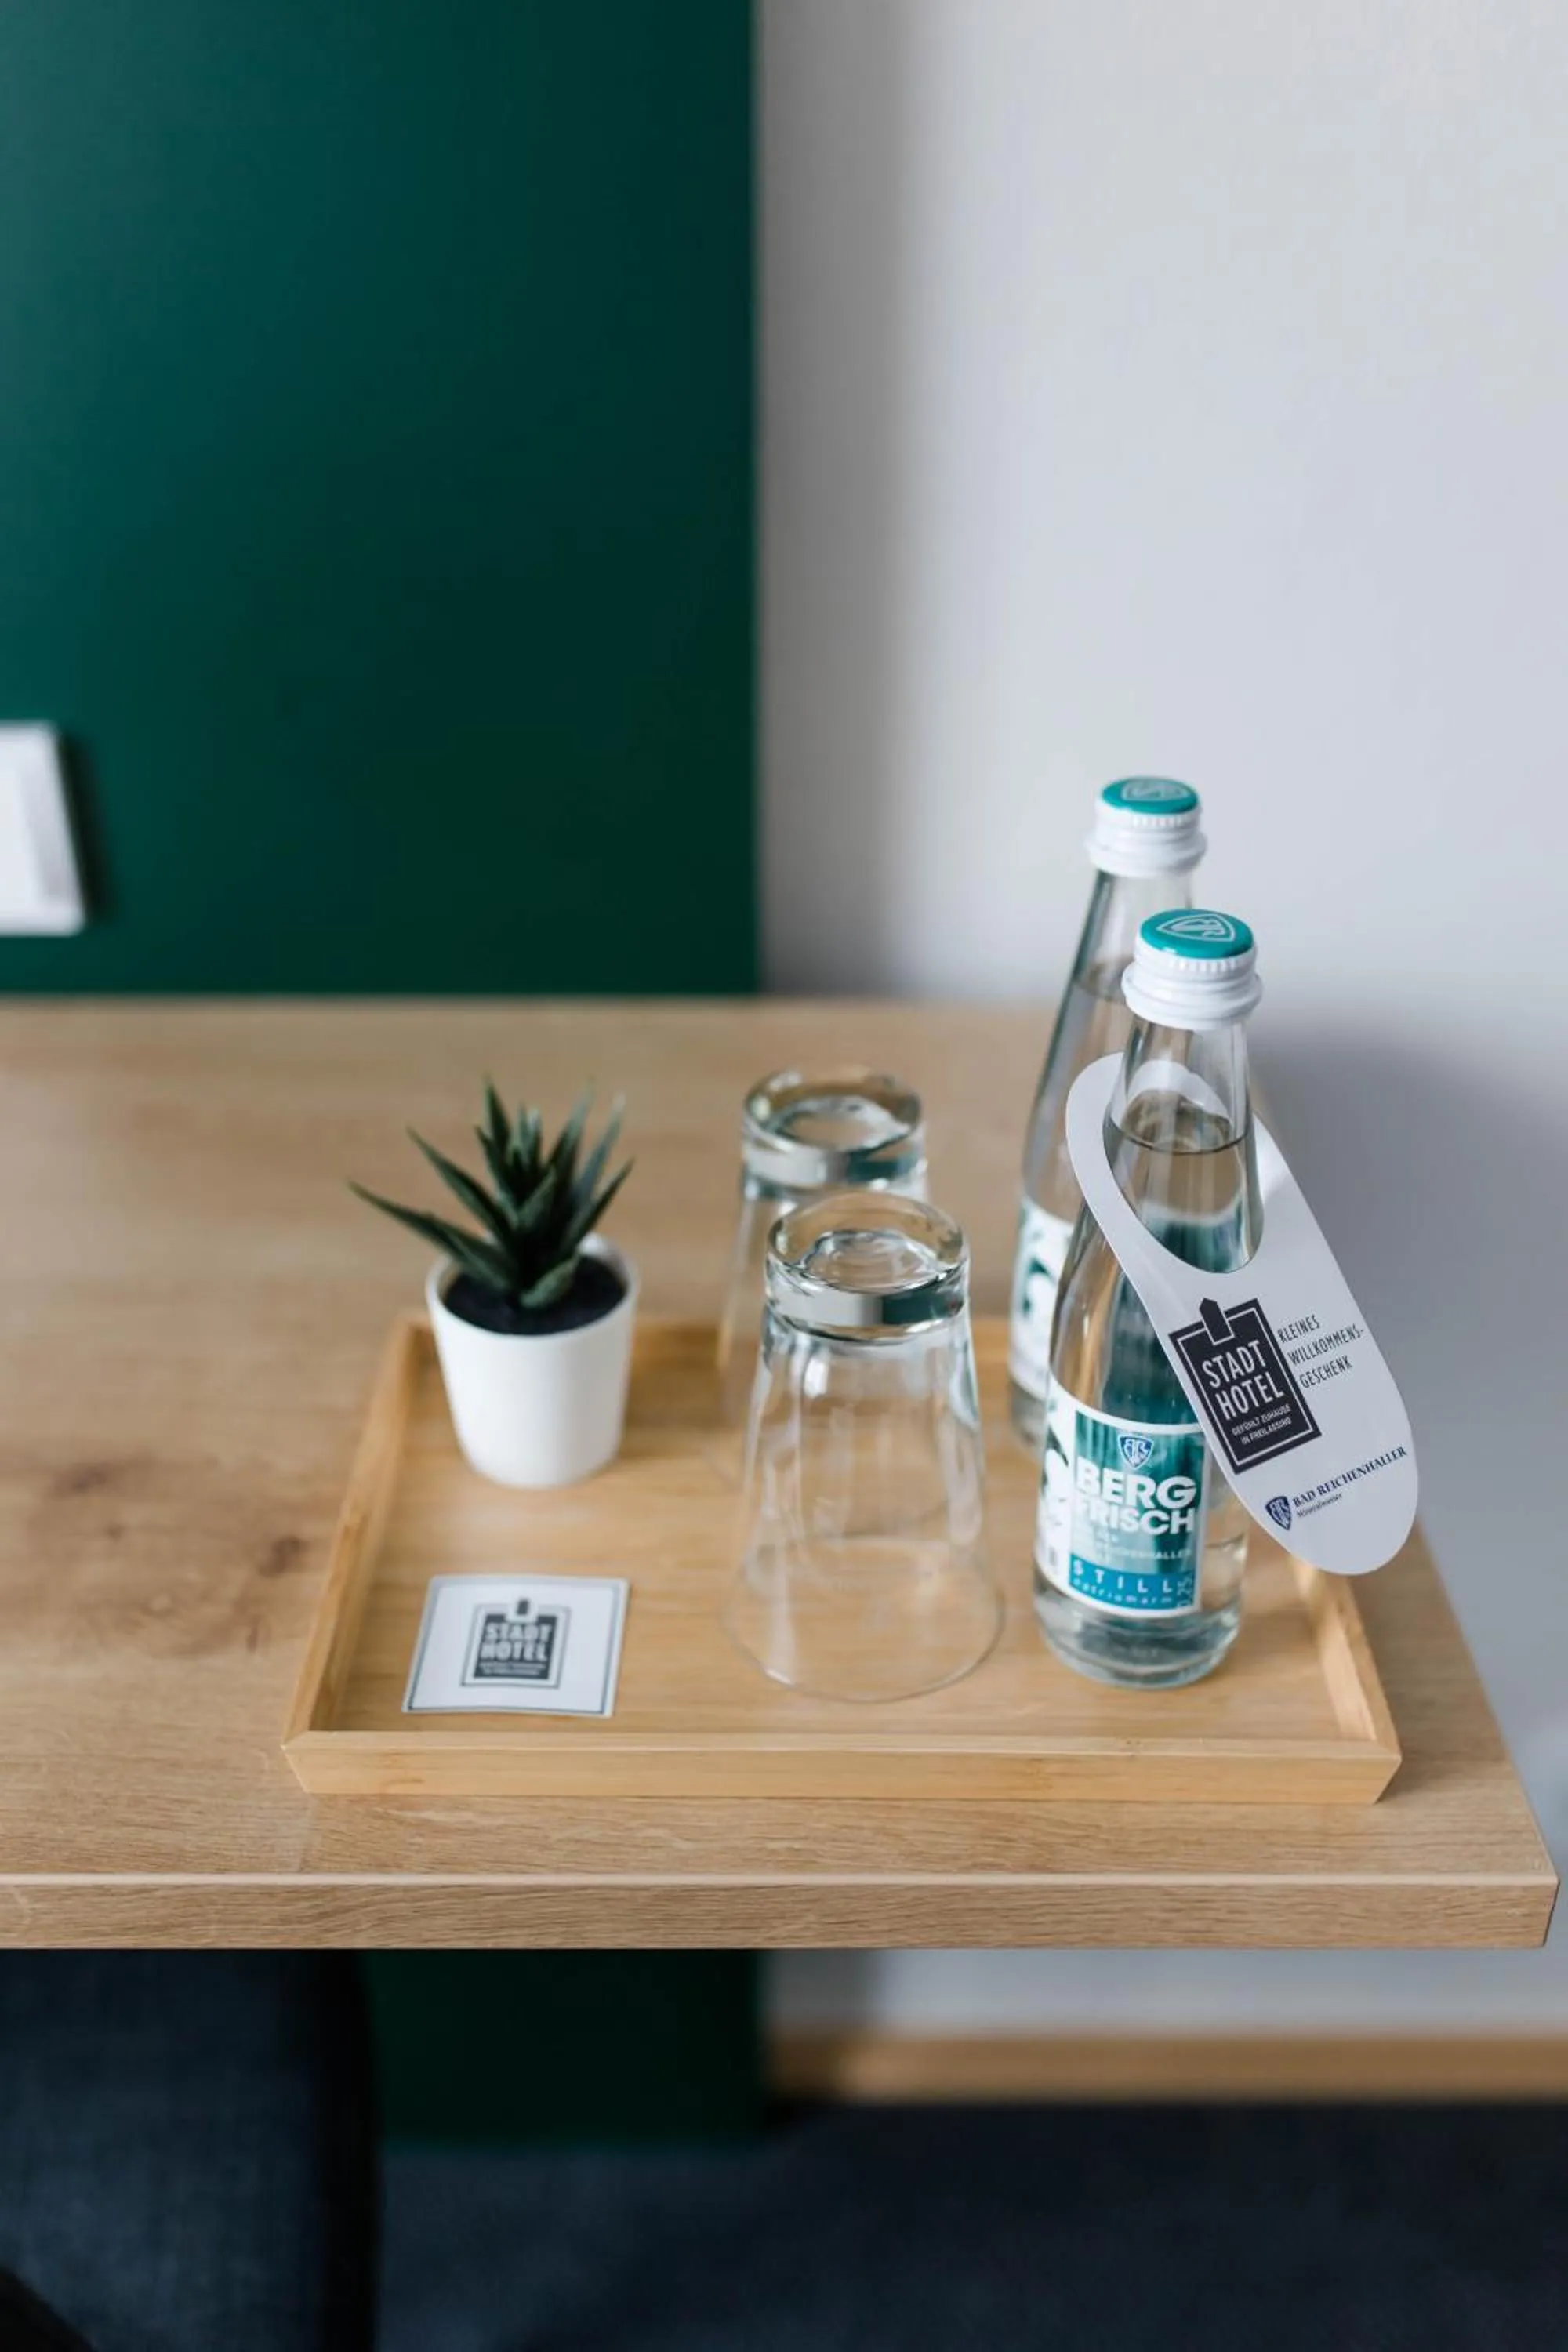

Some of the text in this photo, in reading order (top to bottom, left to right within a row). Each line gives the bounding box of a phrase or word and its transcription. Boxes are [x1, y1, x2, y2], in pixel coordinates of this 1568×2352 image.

[1277, 1314, 1320, 1343] KLEINES
[1287, 1323, 1364, 1366] WILLKOMMENS-
[1202, 1340, 1266, 1388] STADT
[1299, 1355, 1353, 1388] GESCHENK
[1215, 1372, 1284, 1421] HOTEL
[1076, 1457, 1196, 1509] BERG
[1293, 1446, 1407, 1508] BAD REICHENHALLER
[1073, 1559, 1173, 1594] STILL
[485, 1622, 553, 1642] STADT
[479, 1642, 548, 1662] HOTEL
